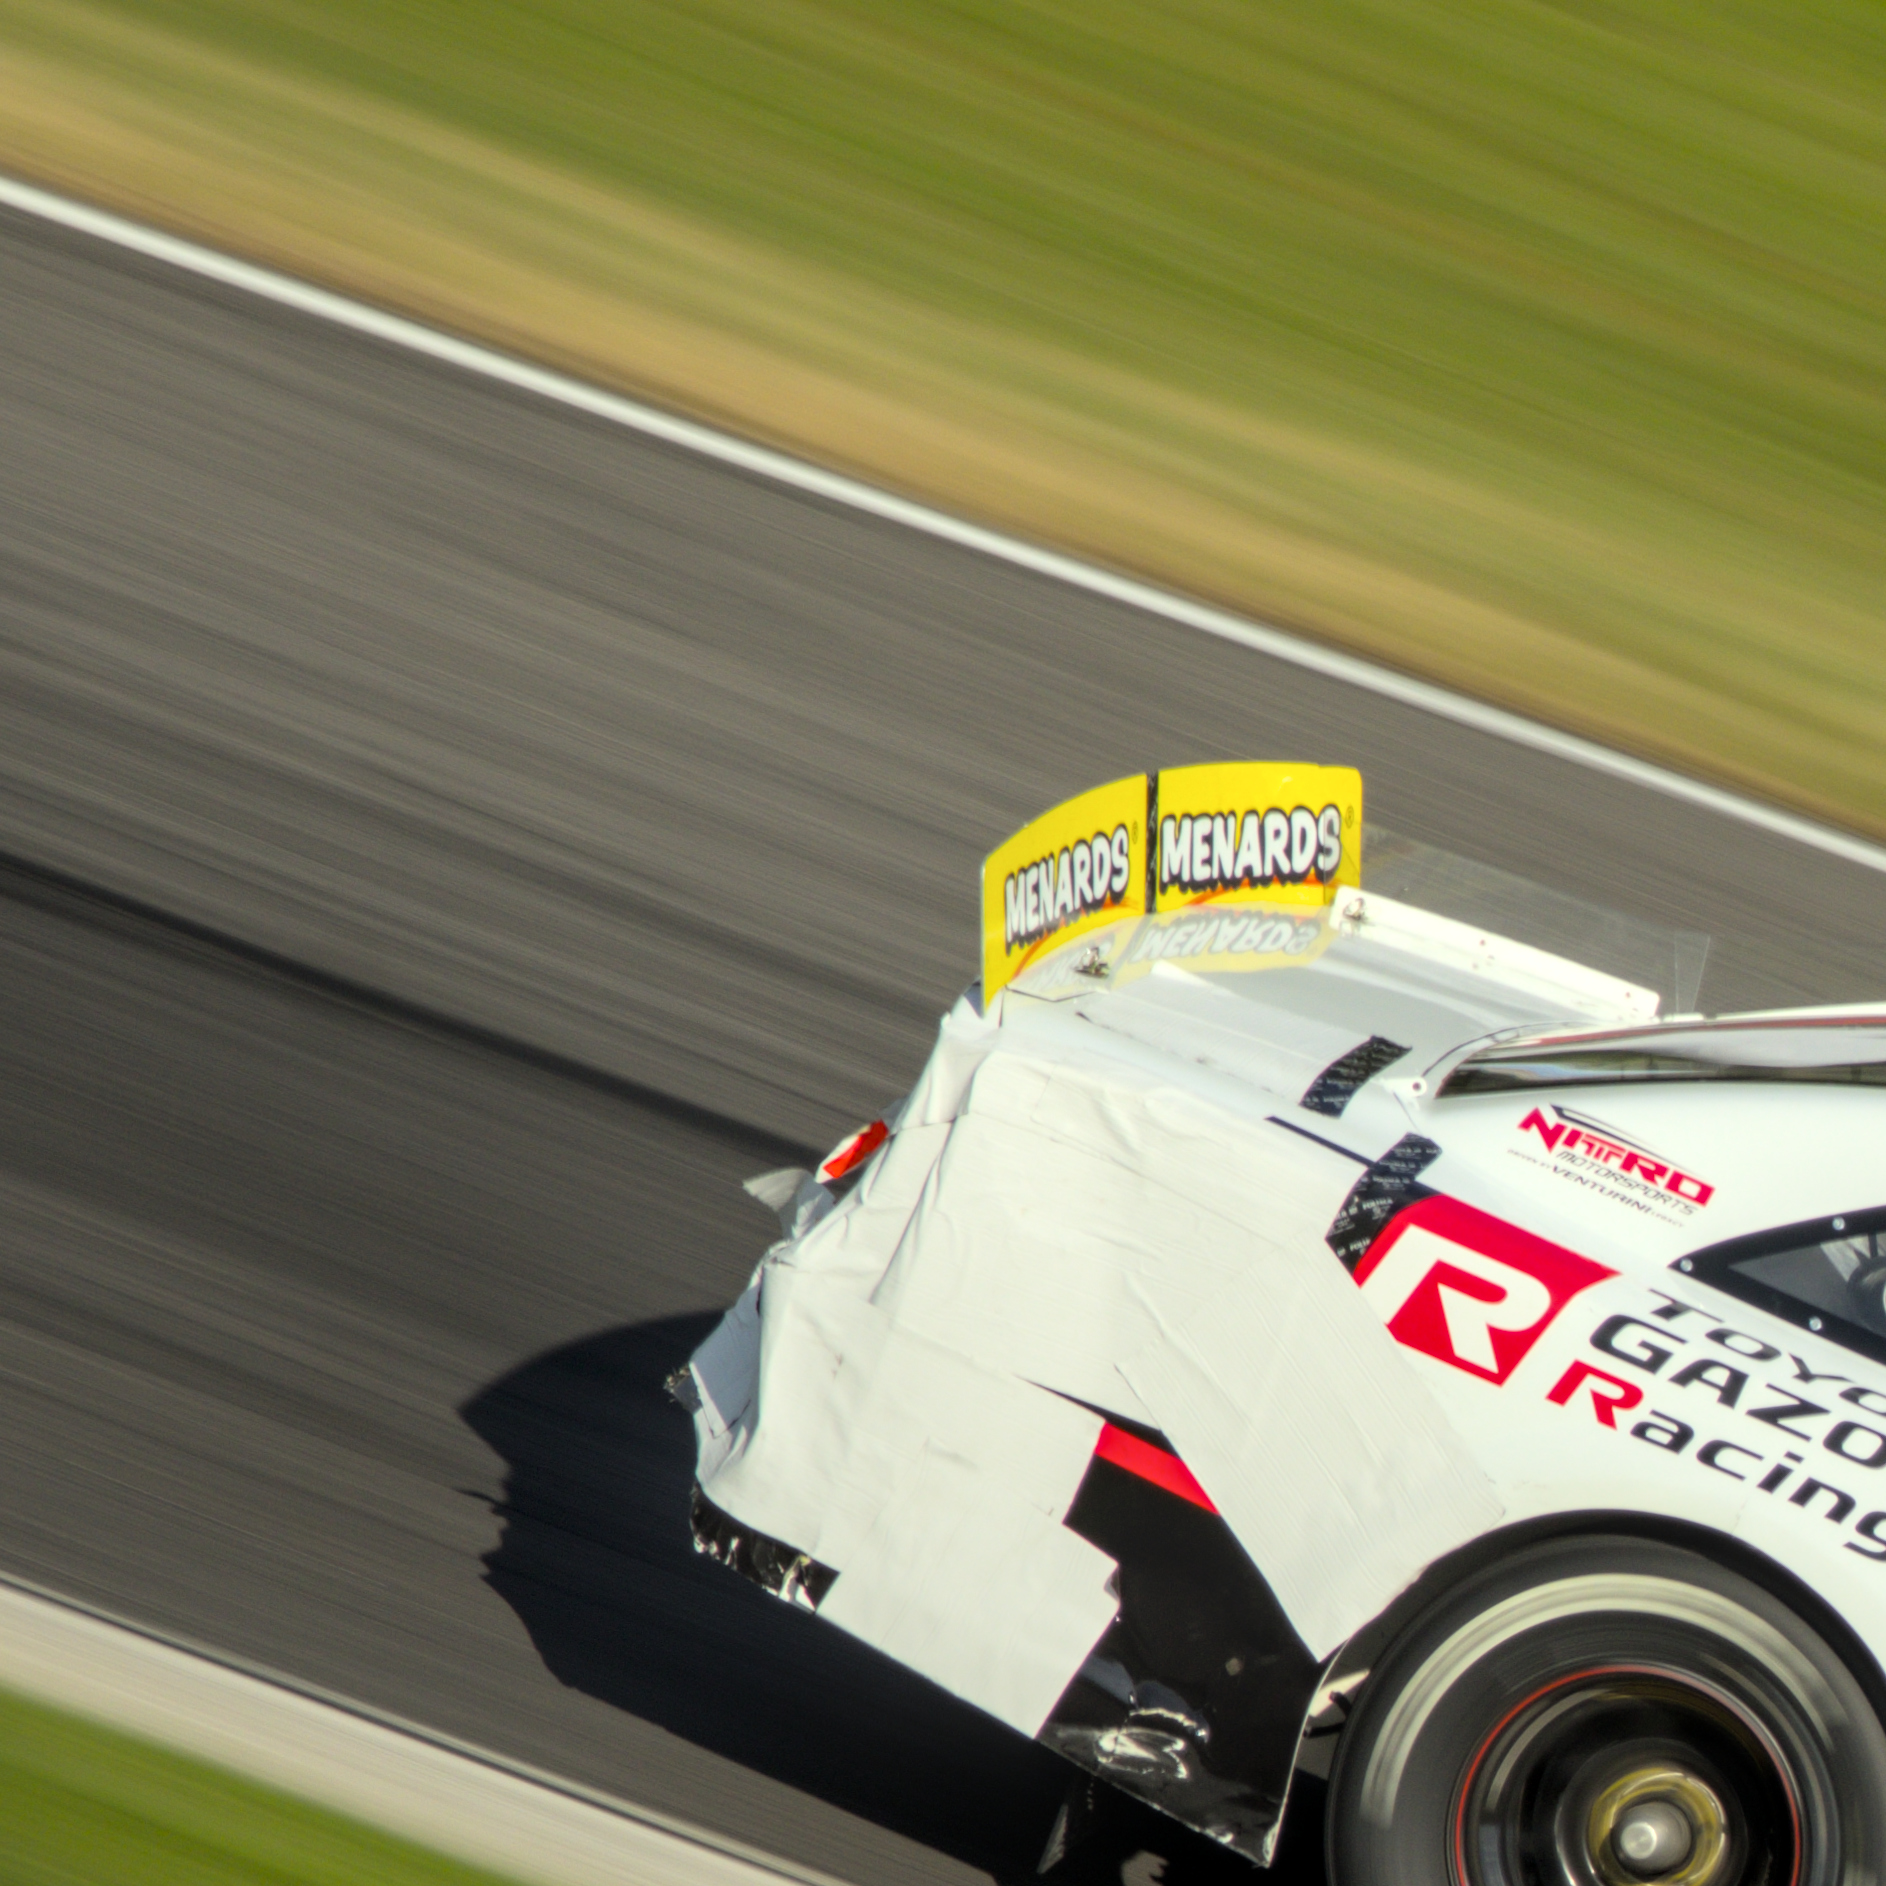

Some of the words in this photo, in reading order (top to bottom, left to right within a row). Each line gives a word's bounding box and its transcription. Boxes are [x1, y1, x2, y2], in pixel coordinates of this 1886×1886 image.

[1158, 804, 1341, 894] MENARDS
[1005, 824, 1129, 956] MENARDS
[1551, 1165, 1652, 1215] VENTURINI
[1555, 1150, 1698, 1216] MOTORSPORTS
